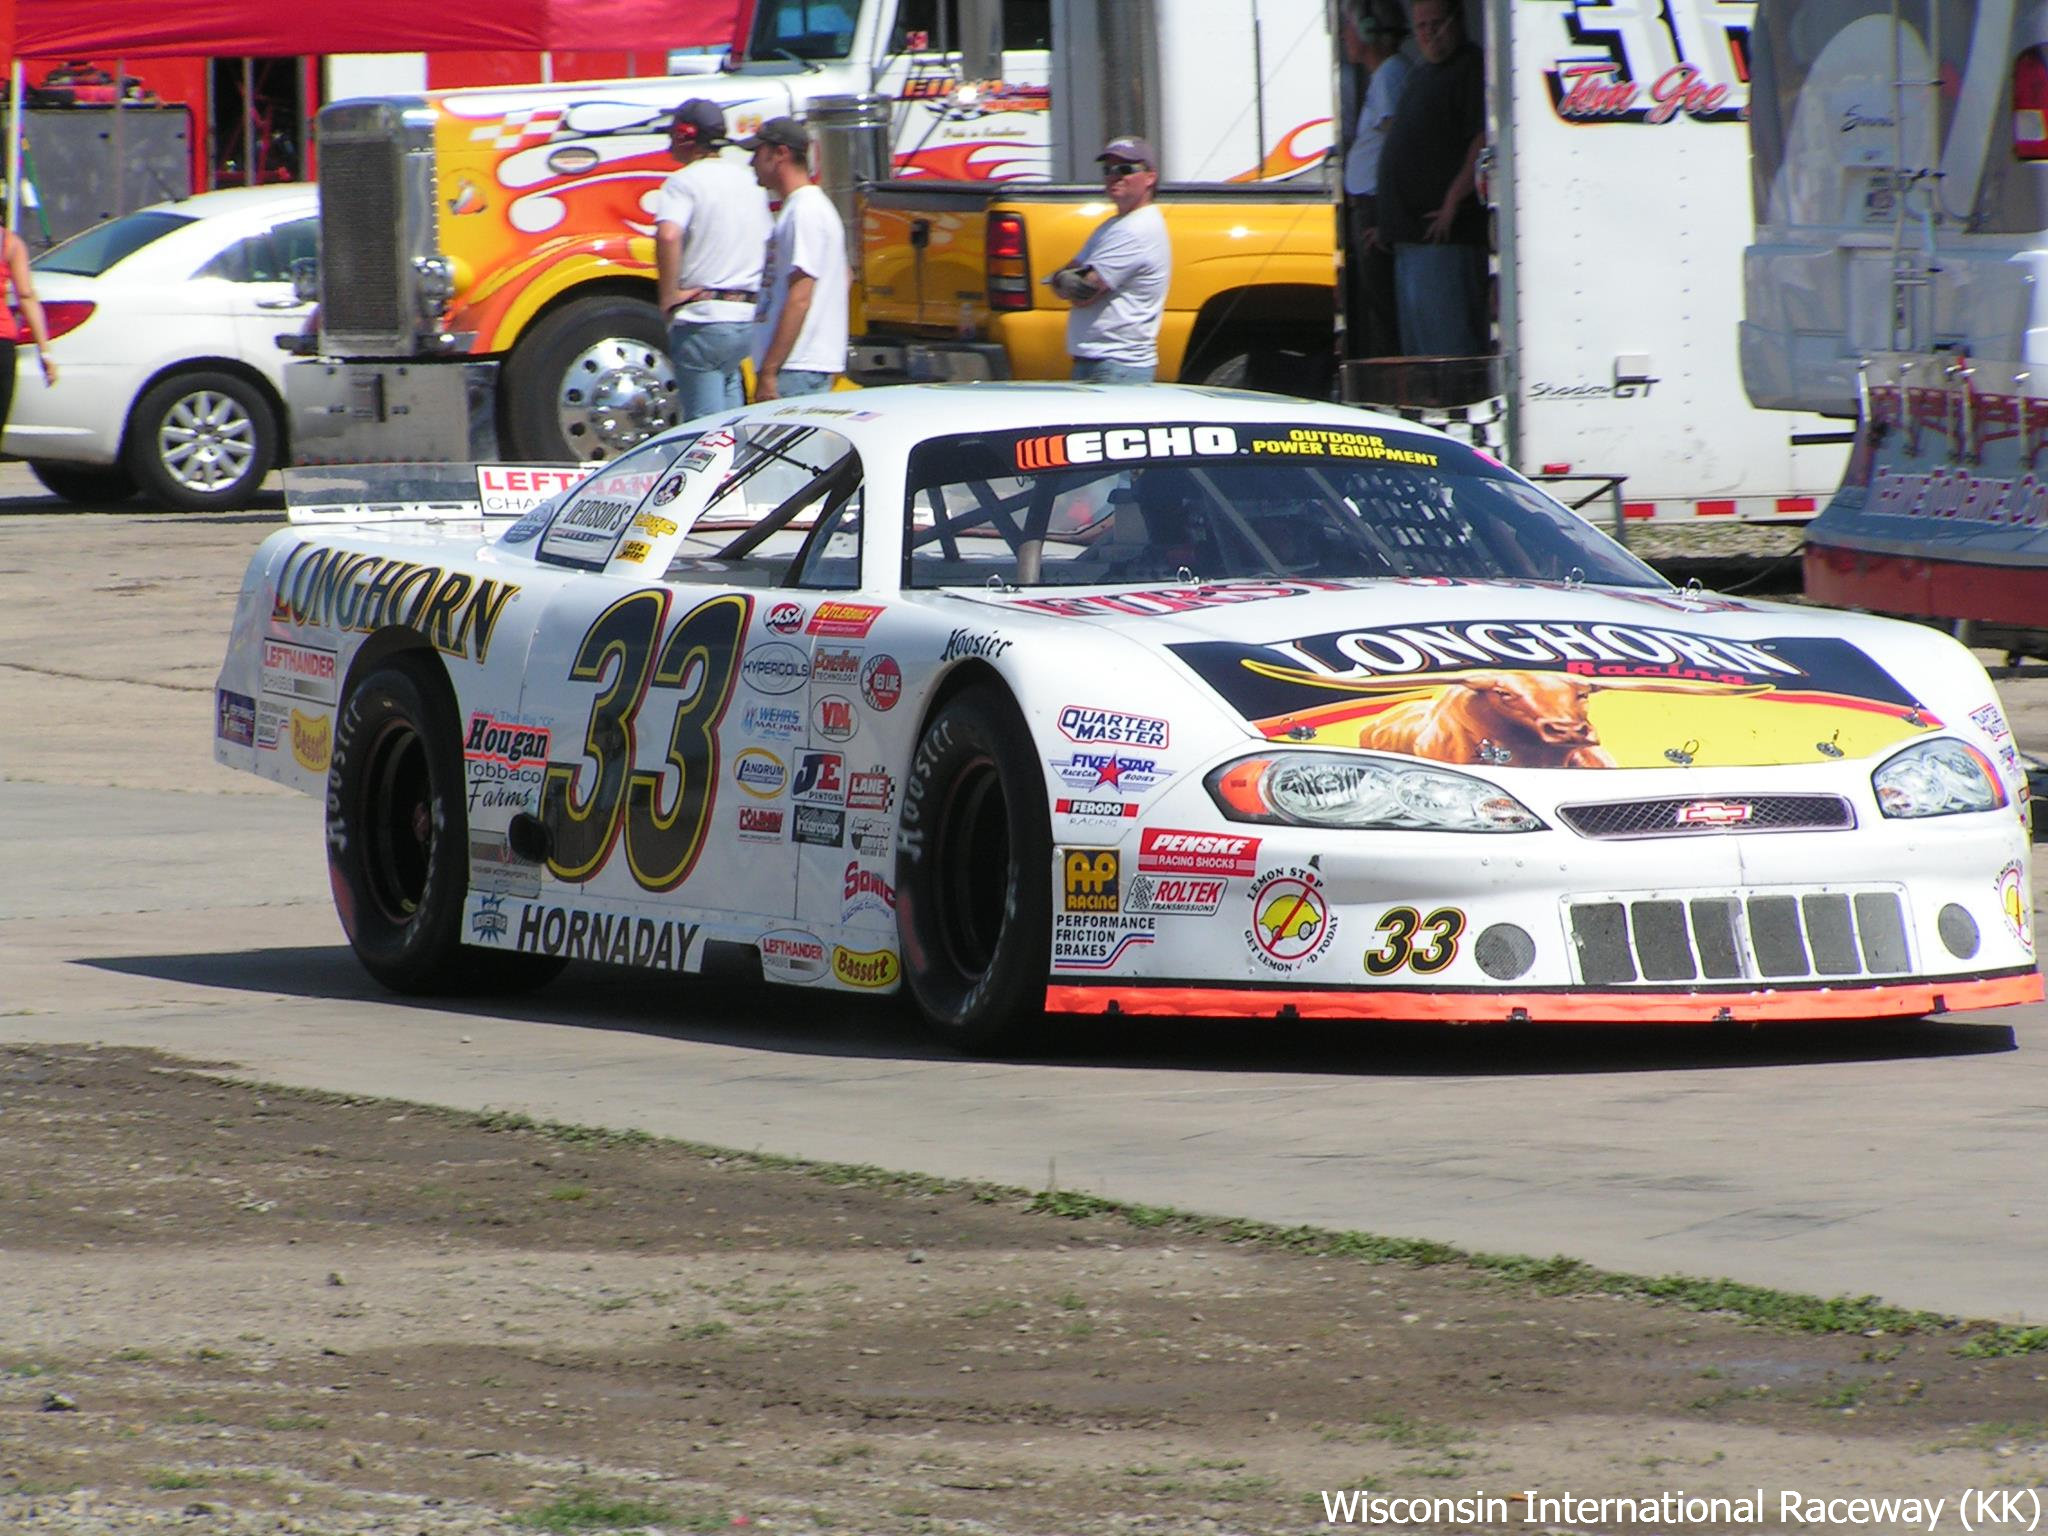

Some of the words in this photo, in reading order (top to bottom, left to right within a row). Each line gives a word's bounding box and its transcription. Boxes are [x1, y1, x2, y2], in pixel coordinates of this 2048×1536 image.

[1644, 62, 1729, 124] Gee
[1067, 427, 1238, 464] ECHO
[1289, 430, 1385, 448] OUTDOOR
[1252, 440, 1325, 456] POWER
[1329, 443, 1438, 467] EQUIPMENT
[271, 541, 521, 665] LONGHORN
[766, 604, 806, 627] ASA
[940, 628, 1013, 661] Hoosier
[1268, 622, 1808, 678] LONGHORN
[264, 644, 335, 679] LEFTHANDER
[743, 659, 808, 677] HYPERCOILS
[1566, 661, 1745, 685] Racing
[759, 706, 800, 724] WEHRS
[1061, 708, 1164, 733] QUARTER
[466, 718, 548, 761] Hougan
[540, 588, 755, 893] 33
[1075, 723, 1164, 746] MASTER
[466, 760, 542, 784] Tobbaco
[736, 759, 785, 781] LANDRUM
[793, 753, 842, 795] JE
[1071, 753, 1110, 768] FIVE
[1118, 757, 1155, 773] STAR
[469, 779, 534, 814] Farms
[852, 777, 885, 794] LANE
[1071, 801, 1122, 816] FERODO
[1151, 833, 1250, 855] PENSKE
[1066, 851, 1117, 893] AP
[1159, 854, 1194, 868] RACING
[1196, 855, 1235, 869] SHOCKS
[844, 861, 897, 910] SONIC
[1154, 880, 1223, 904] ROLTEK
[1247, 867, 1285, 901] LEMON
[1290, 867, 1324, 889] STOP
[1067, 895, 1117, 910] RACING
[1150, 902, 1216, 913] TRANSMISSIONS
[1056, 914, 1156, 930] PERFORMANCE
[518, 903, 700, 973] HORNADAY
[1055, 928, 1116, 943] FRICTION
[1244, 929, 1258, 954] GET
[1257, 951, 1292, 972] LEMON
[1317, 914, 1339, 958] TODAY
[1363, 906, 1467, 976] 33
[763, 937, 823, 961] LEFTHANDER
[1055, 943, 1107, 957] BRAKES
[838, 951, 890, 982] Bassett
